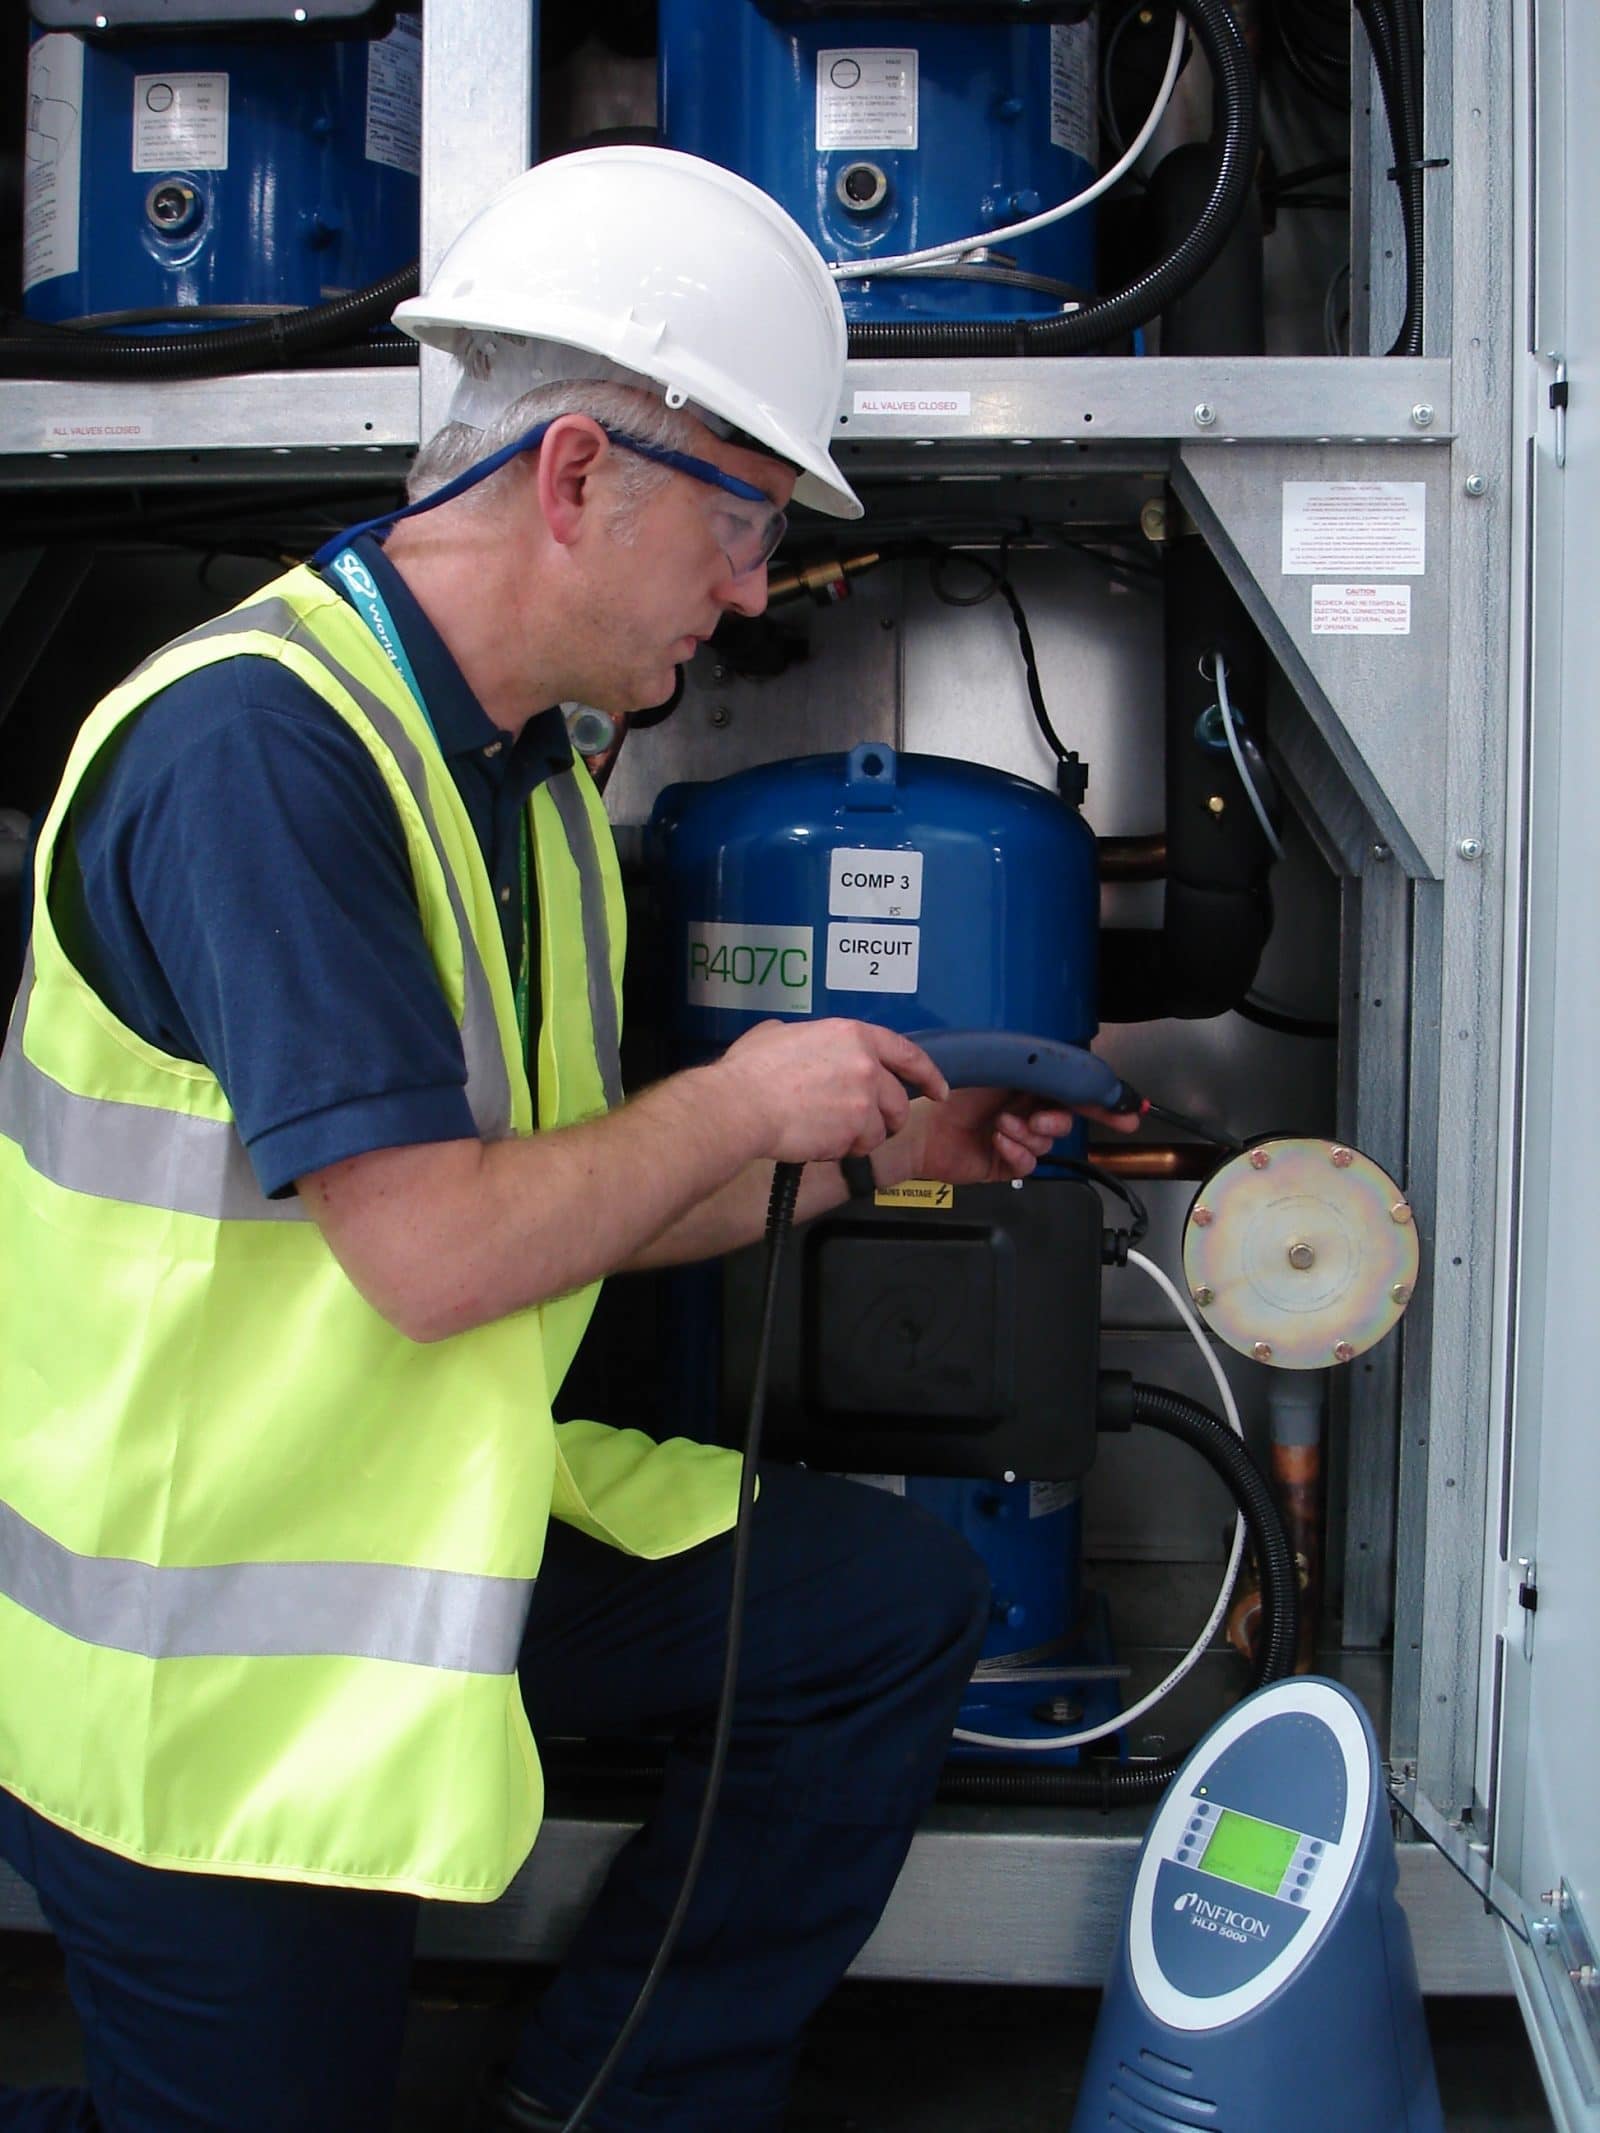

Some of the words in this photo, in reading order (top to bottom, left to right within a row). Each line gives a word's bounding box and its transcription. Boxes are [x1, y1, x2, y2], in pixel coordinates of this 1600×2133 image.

[862, 401, 878, 410] ALL
[880, 401, 916, 410] VALVES
[918, 401, 957, 410] CLOSED
[53, 427, 68, 436] ALL
[71, 426, 103, 435] VALVES
[104, 425, 140, 435] CLOSED
[1345, 588, 1376, 596] CAUTION
[368, 603, 398, 661] World
[840, 872, 895, 889] COMP
[900, 875, 910, 890] 3
[839, 939, 913, 956] CIRCUIT
[691, 942, 808, 988] R407C
[869, 961, 880, 976] 2
[902, 1188, 932, 1199] VOLTAGE
[1195, 1898, 1270, 1938] INFICON
[1192, 1916, 1217, 1932] HLD
[1218, 1926, 1248, 1943] 5000
